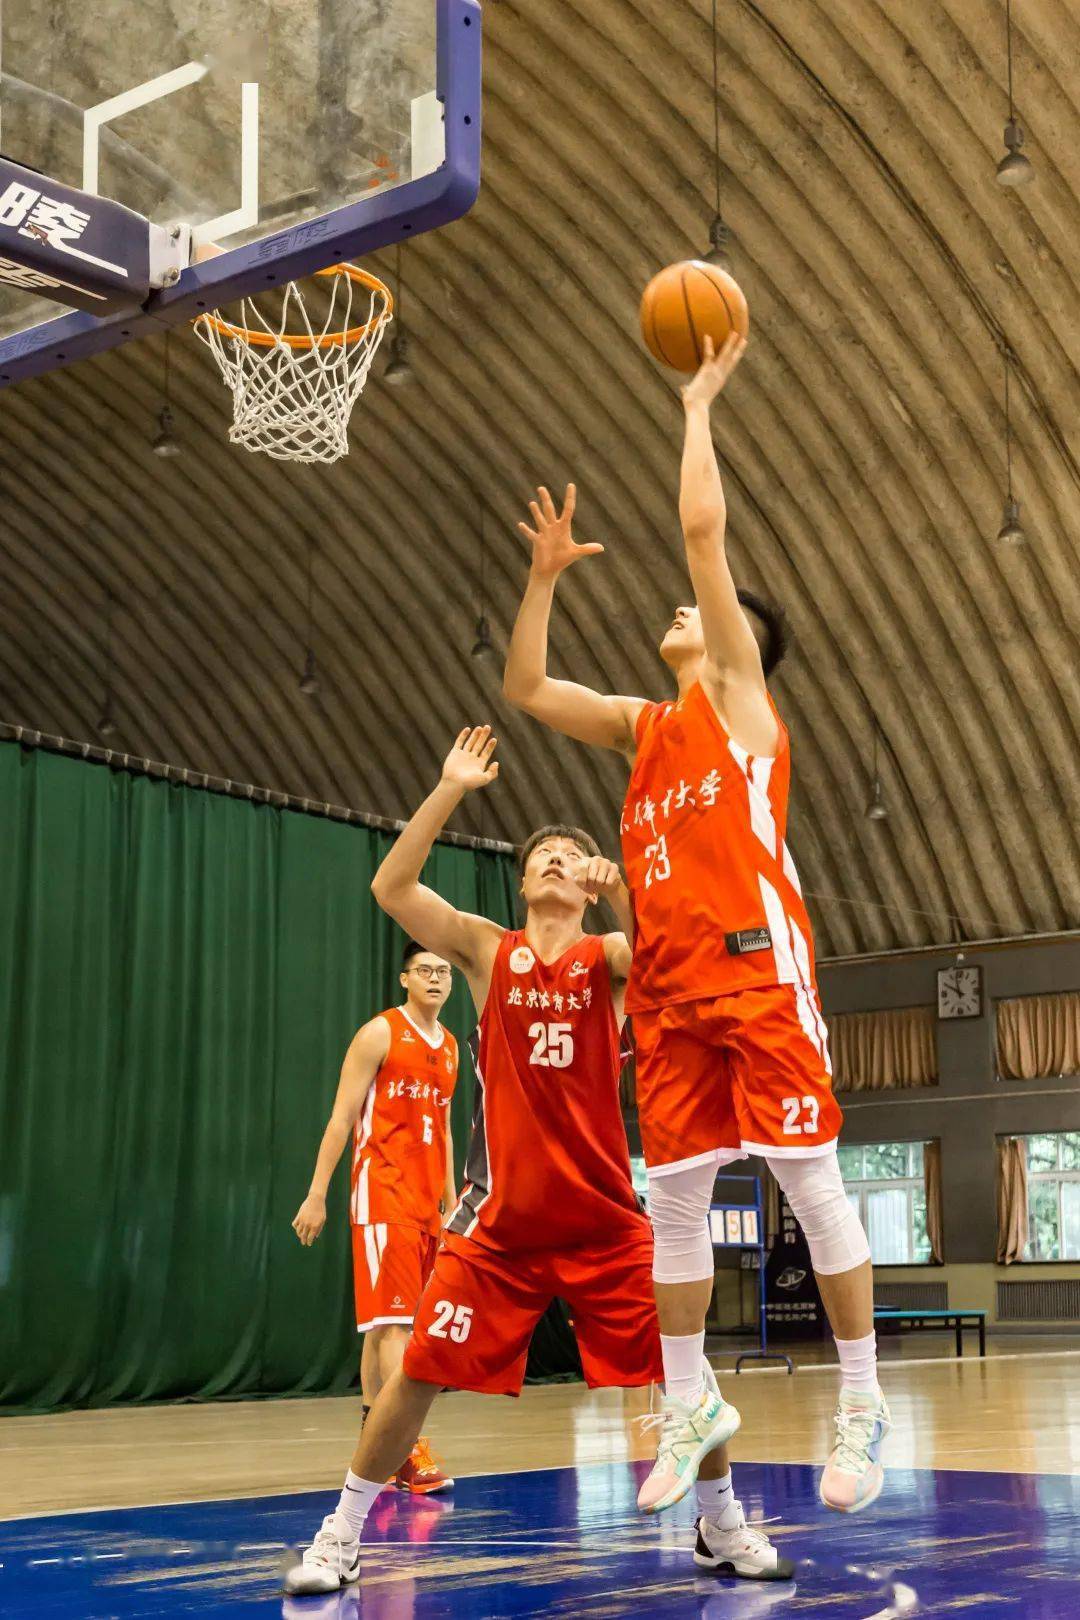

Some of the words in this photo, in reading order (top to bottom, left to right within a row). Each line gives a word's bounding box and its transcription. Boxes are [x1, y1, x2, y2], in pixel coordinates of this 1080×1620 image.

[528, 1022, 574, 1068] 25
[781, 1095, 820, 1135] 23
[427, 1300, 474, 1343] 25
